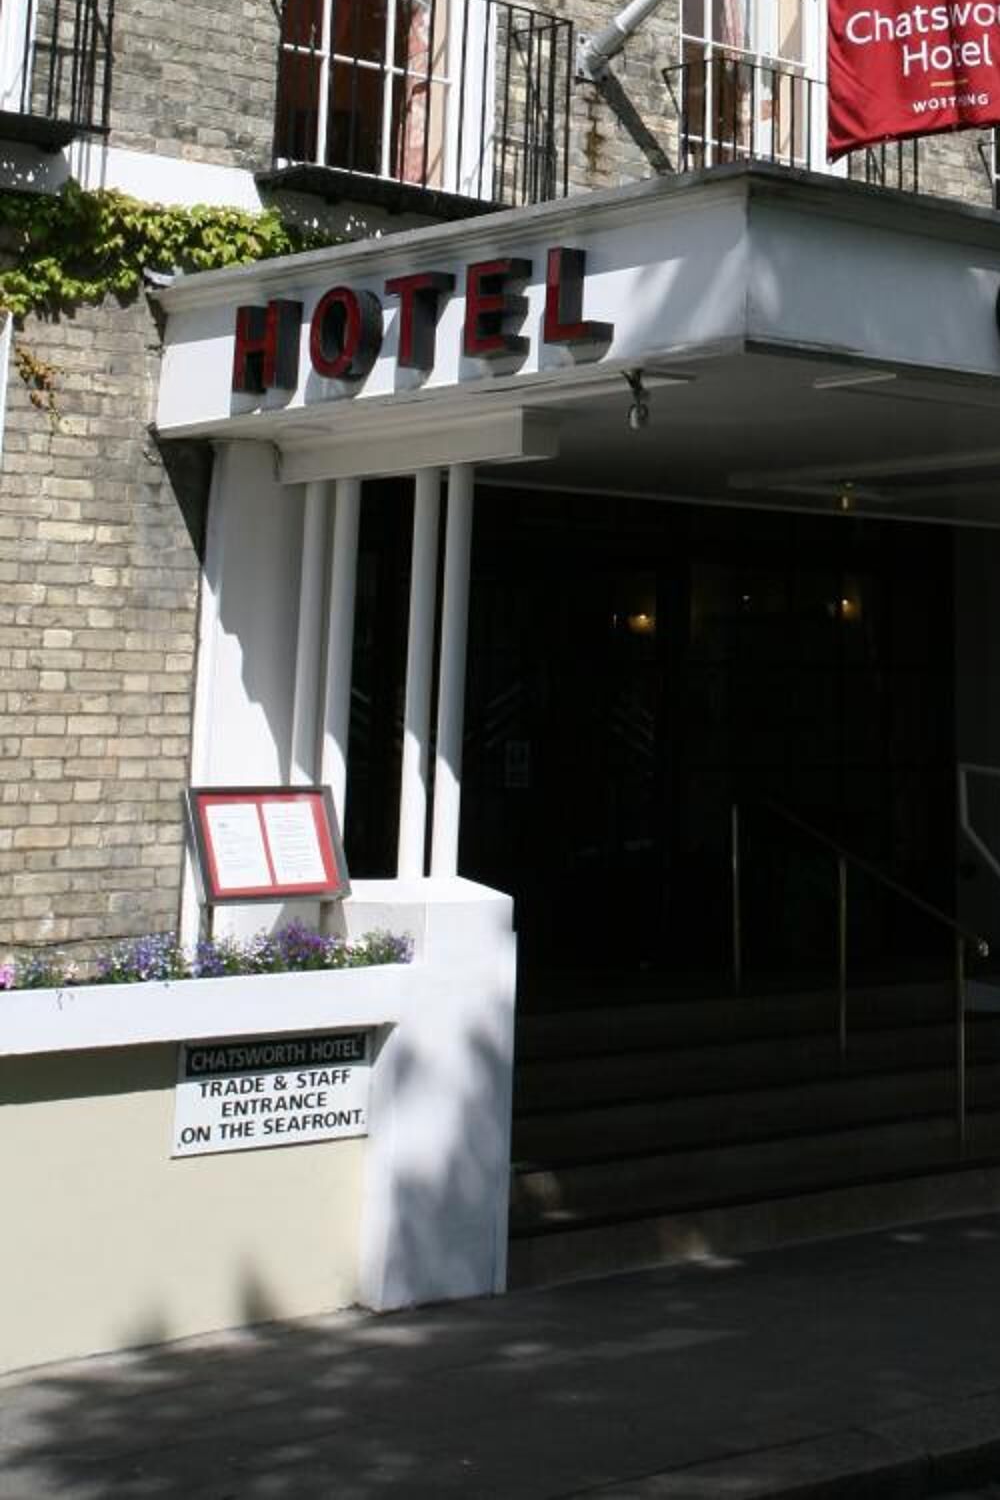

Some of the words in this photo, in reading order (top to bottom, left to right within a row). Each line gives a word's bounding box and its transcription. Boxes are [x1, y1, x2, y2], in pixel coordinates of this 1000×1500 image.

[902, 33, 994, 77] Hotel
[911, 92, 990, 114] WORTNG
[232, 246, 614, 394] HOTEL
[191, 1043, 306, 1071] CHATSWORTH
[311, 1039, 360, 1060] HOTEL
[199, 1076, 265, 1098] TRADE
[273, 1075, 288, 1091] &
[296, 1068, 352, 1089] STAFF
[221, 1091, 328, 1118] ENTRANCE
[181, 1125, 211, 1145] ON
[219, 1121, 255, 1140] THE
[263, 1108, 363, 1135] SEAFRONT
